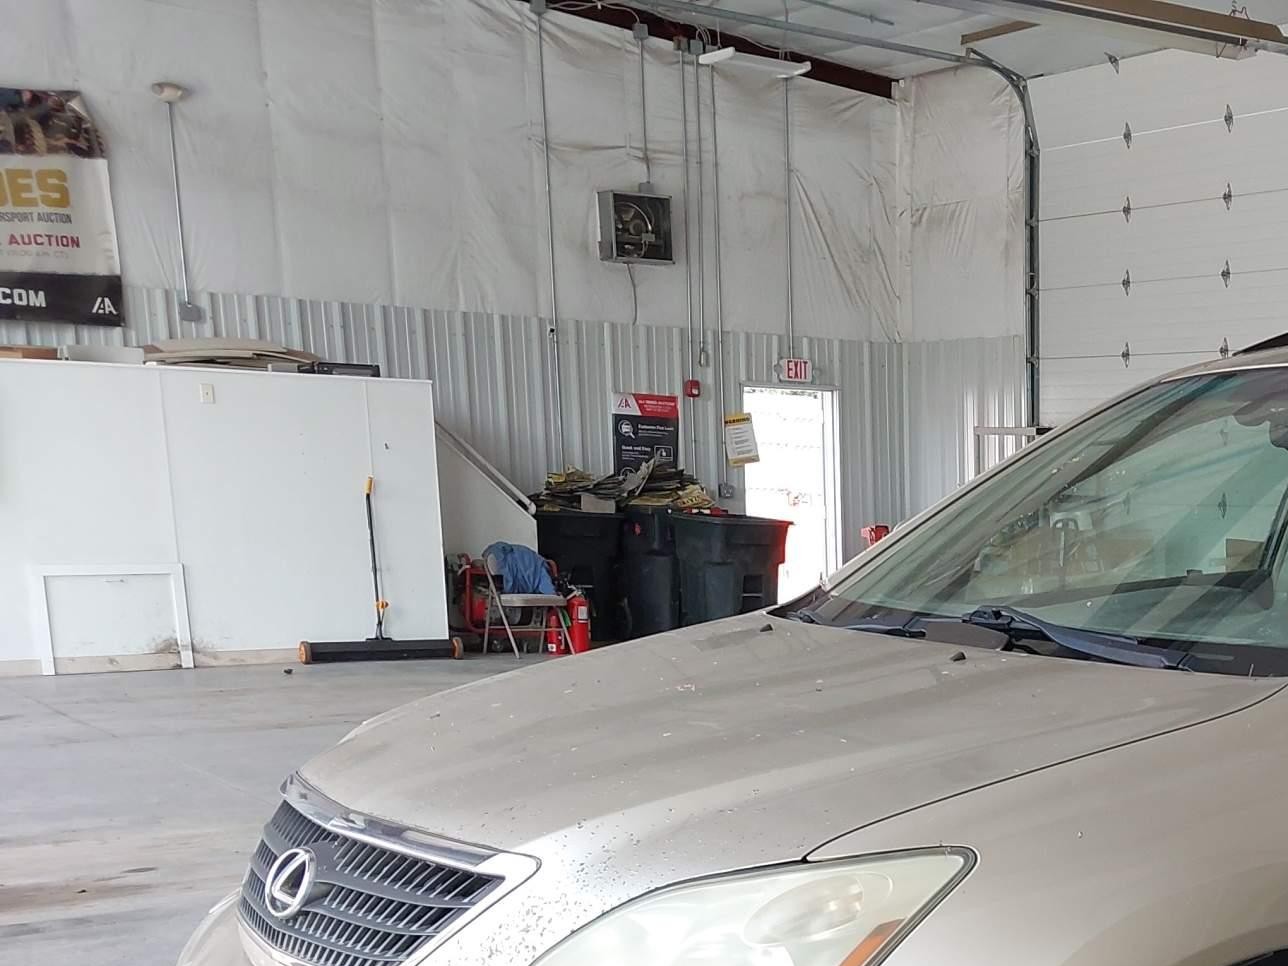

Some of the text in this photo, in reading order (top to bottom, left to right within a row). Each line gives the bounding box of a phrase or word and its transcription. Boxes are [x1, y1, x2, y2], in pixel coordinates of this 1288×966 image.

[37, 212, 72, 224] AUCTION
[8, 233, 81, 248] AUCTION
[787, 360, 808, 379] EXIT
